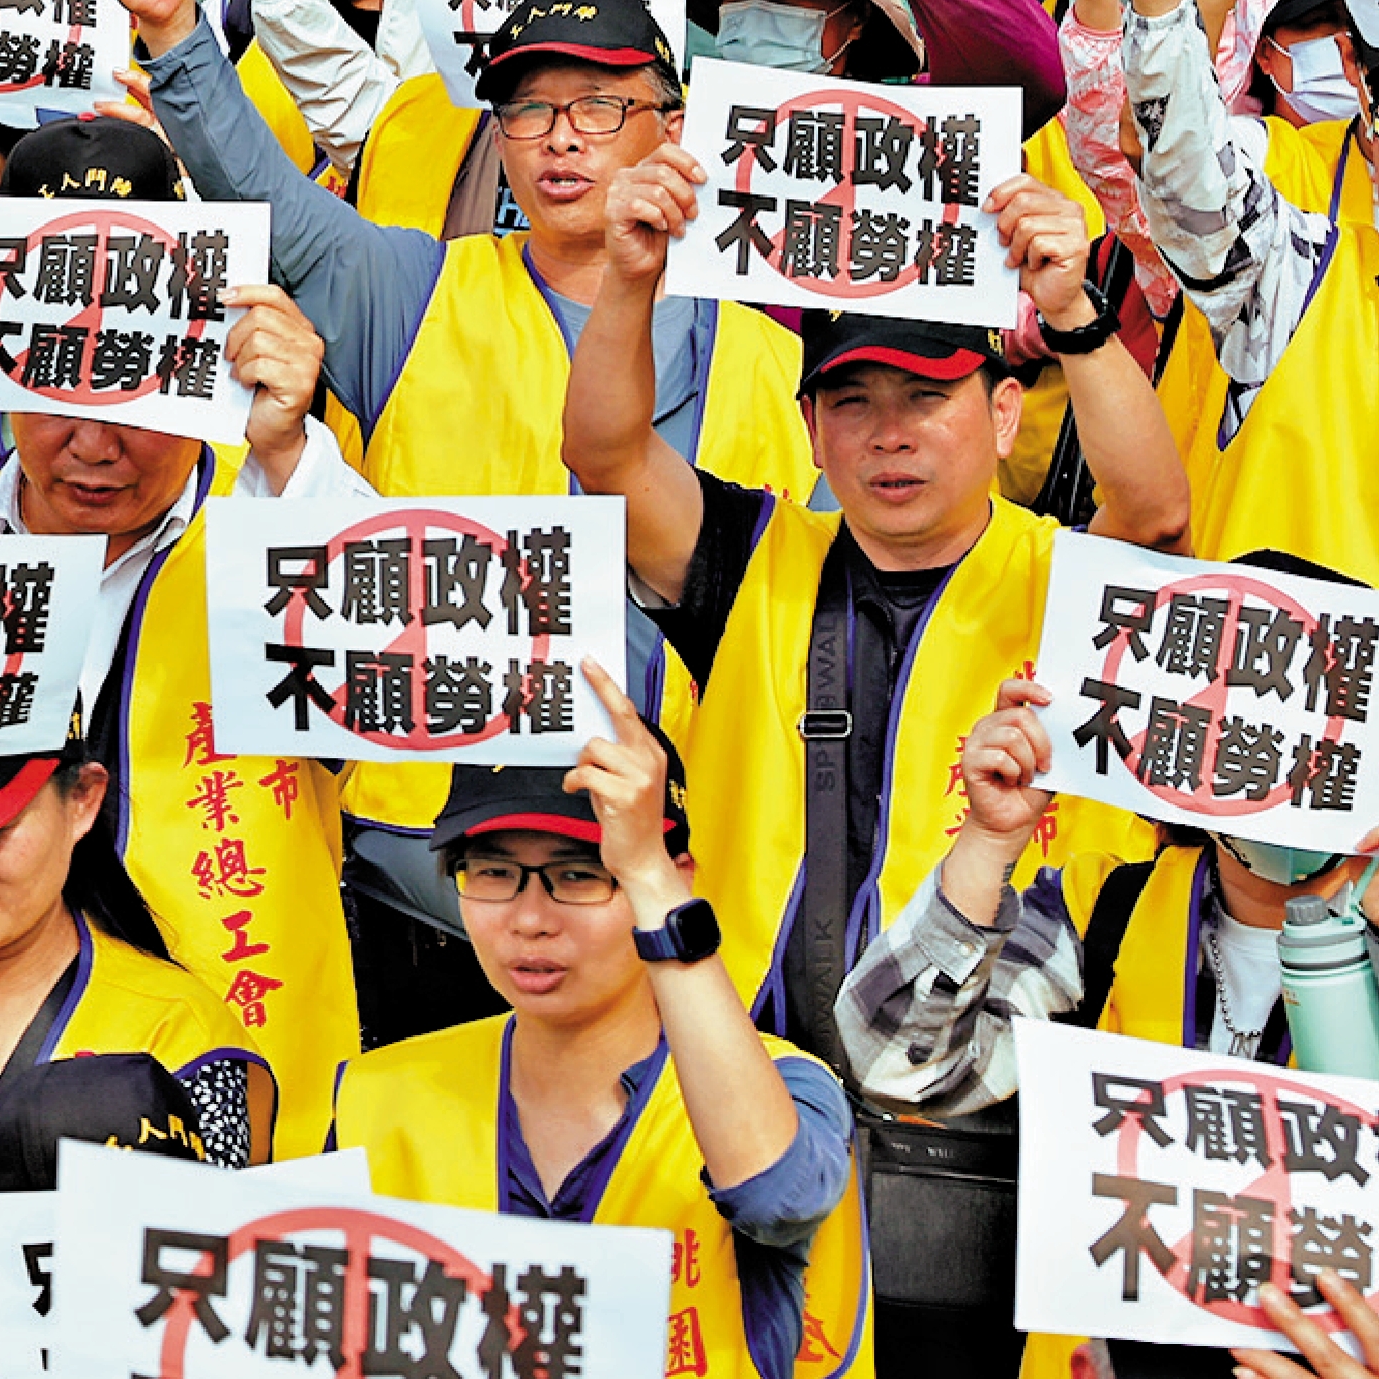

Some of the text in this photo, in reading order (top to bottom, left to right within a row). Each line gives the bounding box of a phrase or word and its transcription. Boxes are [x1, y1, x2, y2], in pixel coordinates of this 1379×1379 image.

[720, 106, 981, 208] 只顧政權
[715, 188, 977, 286] 不顧勞權
[265, 525, 573, 636] 只顧政權
[265, 642, 574, 734] 不顧勞權
[1091, 582, 1375, 721] 只顧政權
[1071, 677, 1362, 812] 不顧勞權
[182, 702, 284, 1028] 產業總工會
[134, 1227, 586, 1379] 只顧政權
